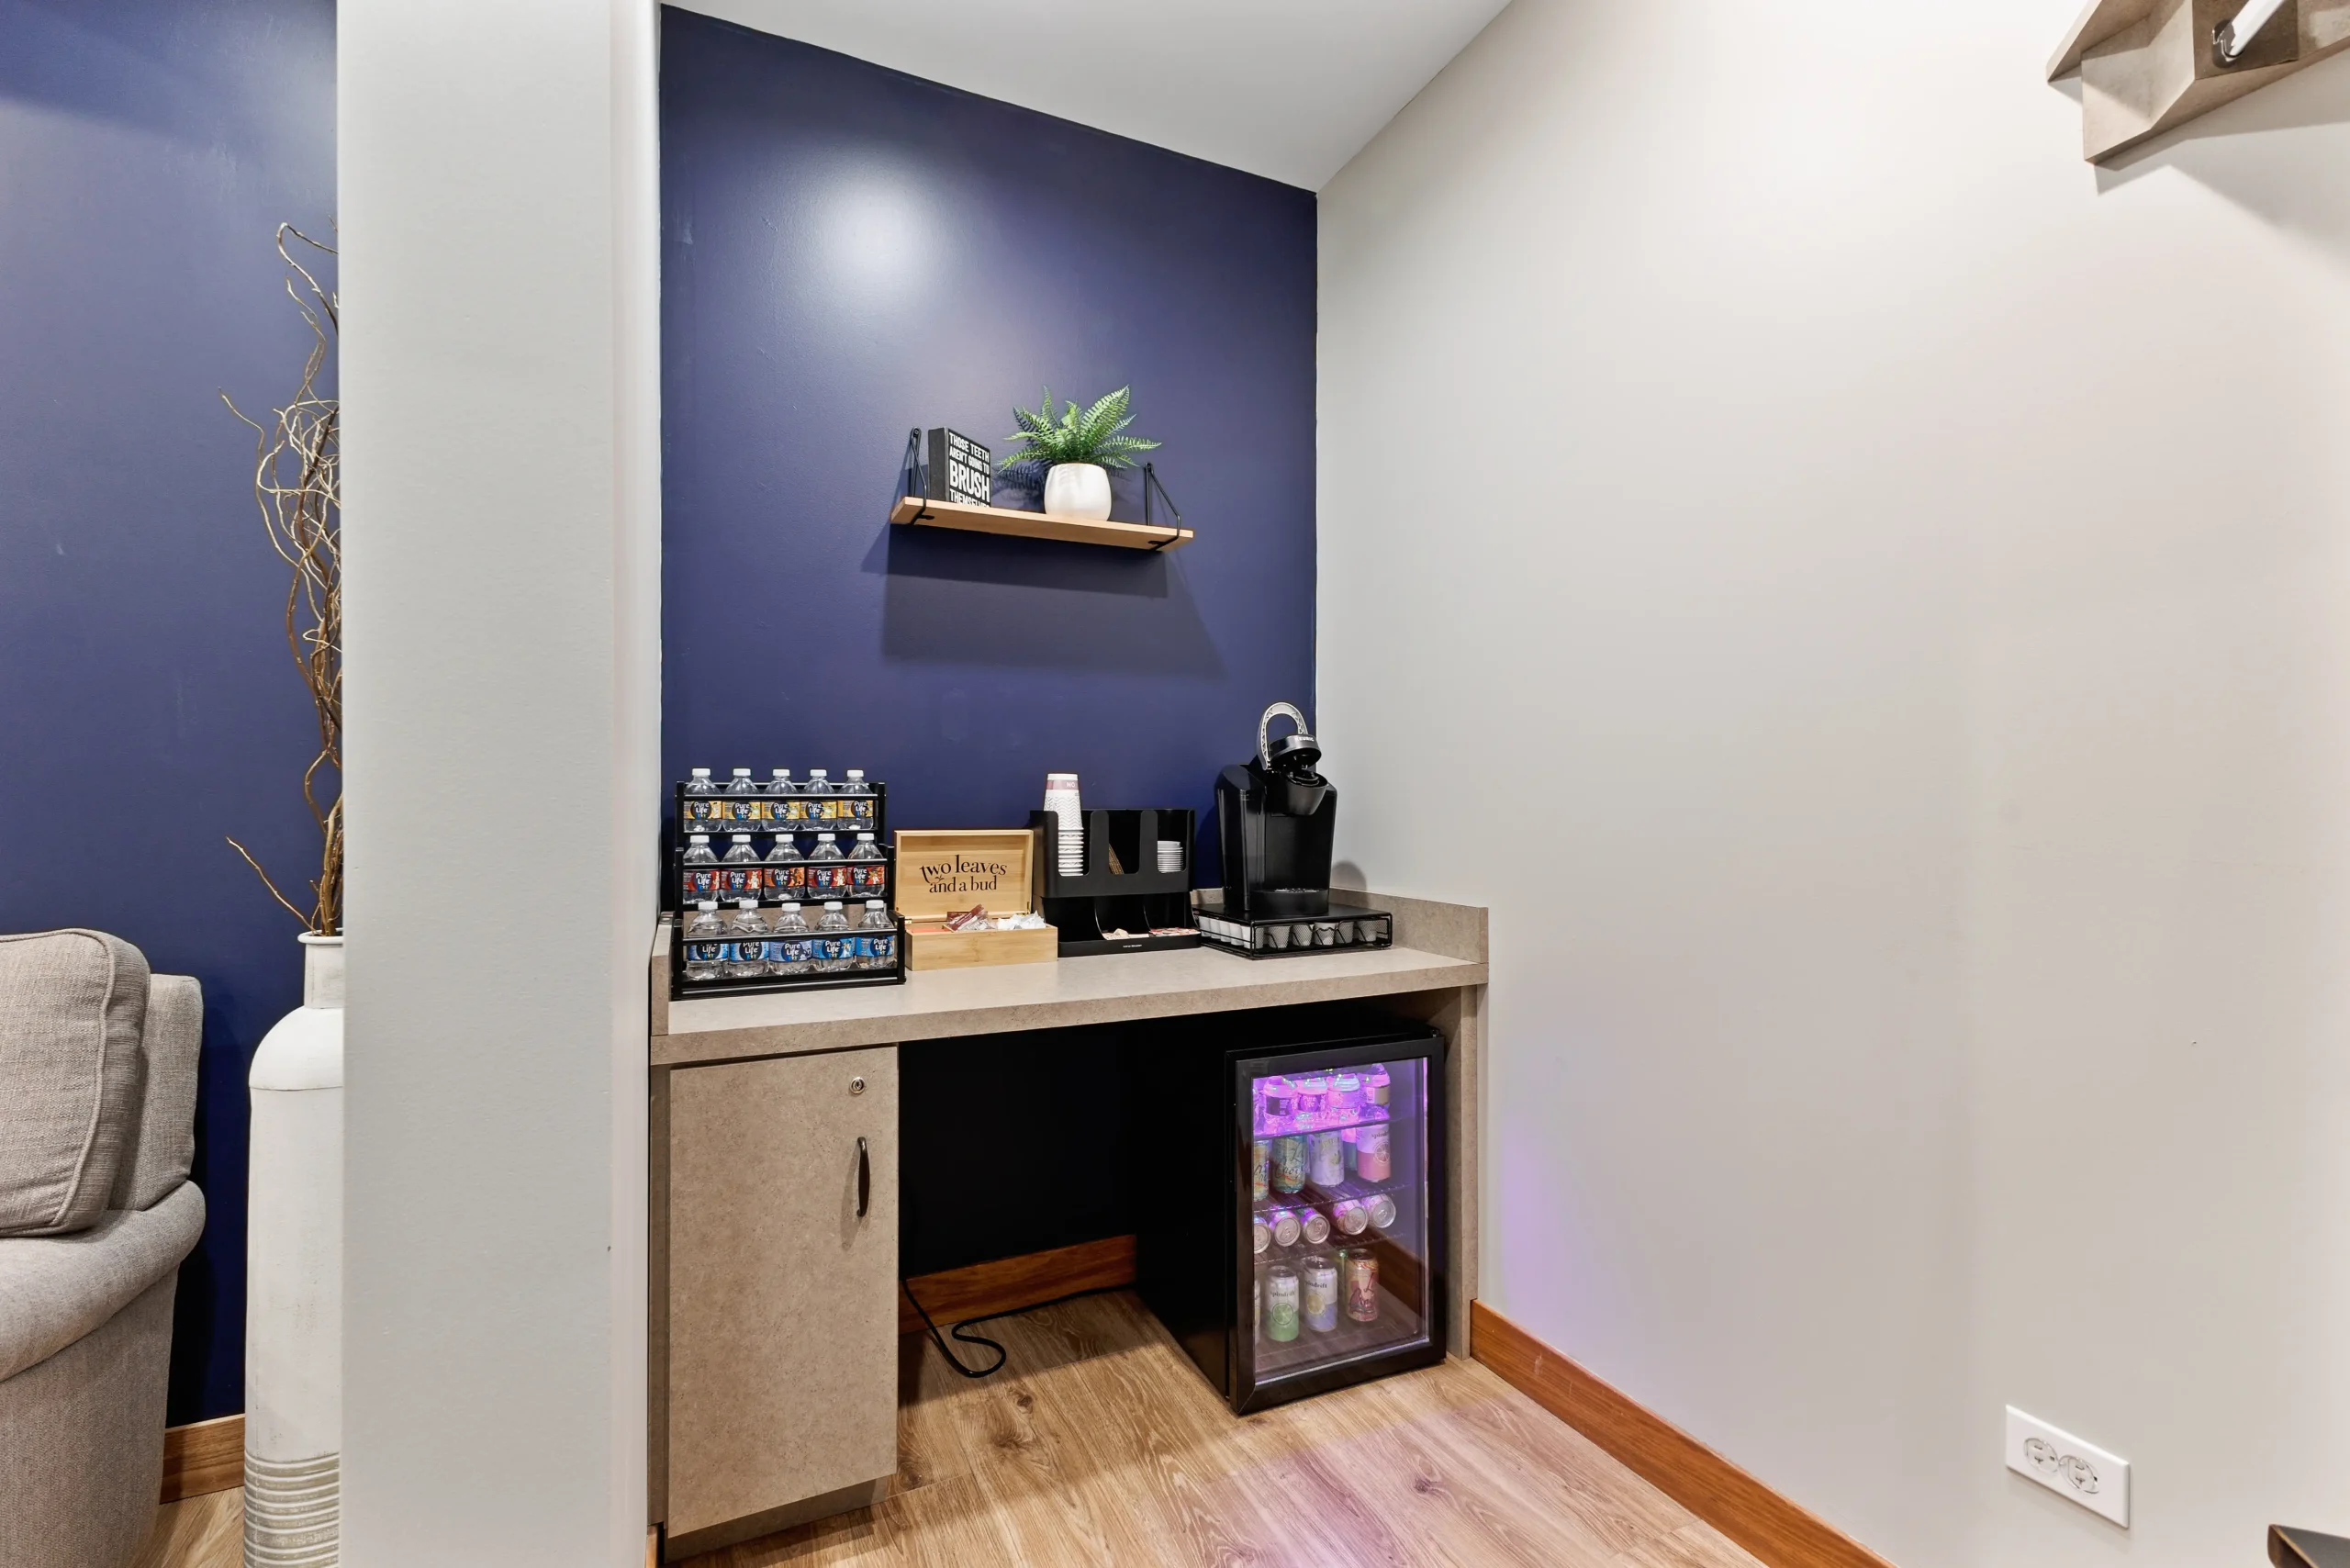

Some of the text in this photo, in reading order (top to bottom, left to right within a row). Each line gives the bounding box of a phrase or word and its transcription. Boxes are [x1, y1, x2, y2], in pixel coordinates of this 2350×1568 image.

[949, 432, 990, 463] THOSE TEETH
[968, 454, 983, 472] GOING
[983, 462, 990, 475] TO
[949, 458, 990, 503] BRUSH
[919, 855, 1008, 884] two leaves
[929, 875, 997, 893] and a bud
